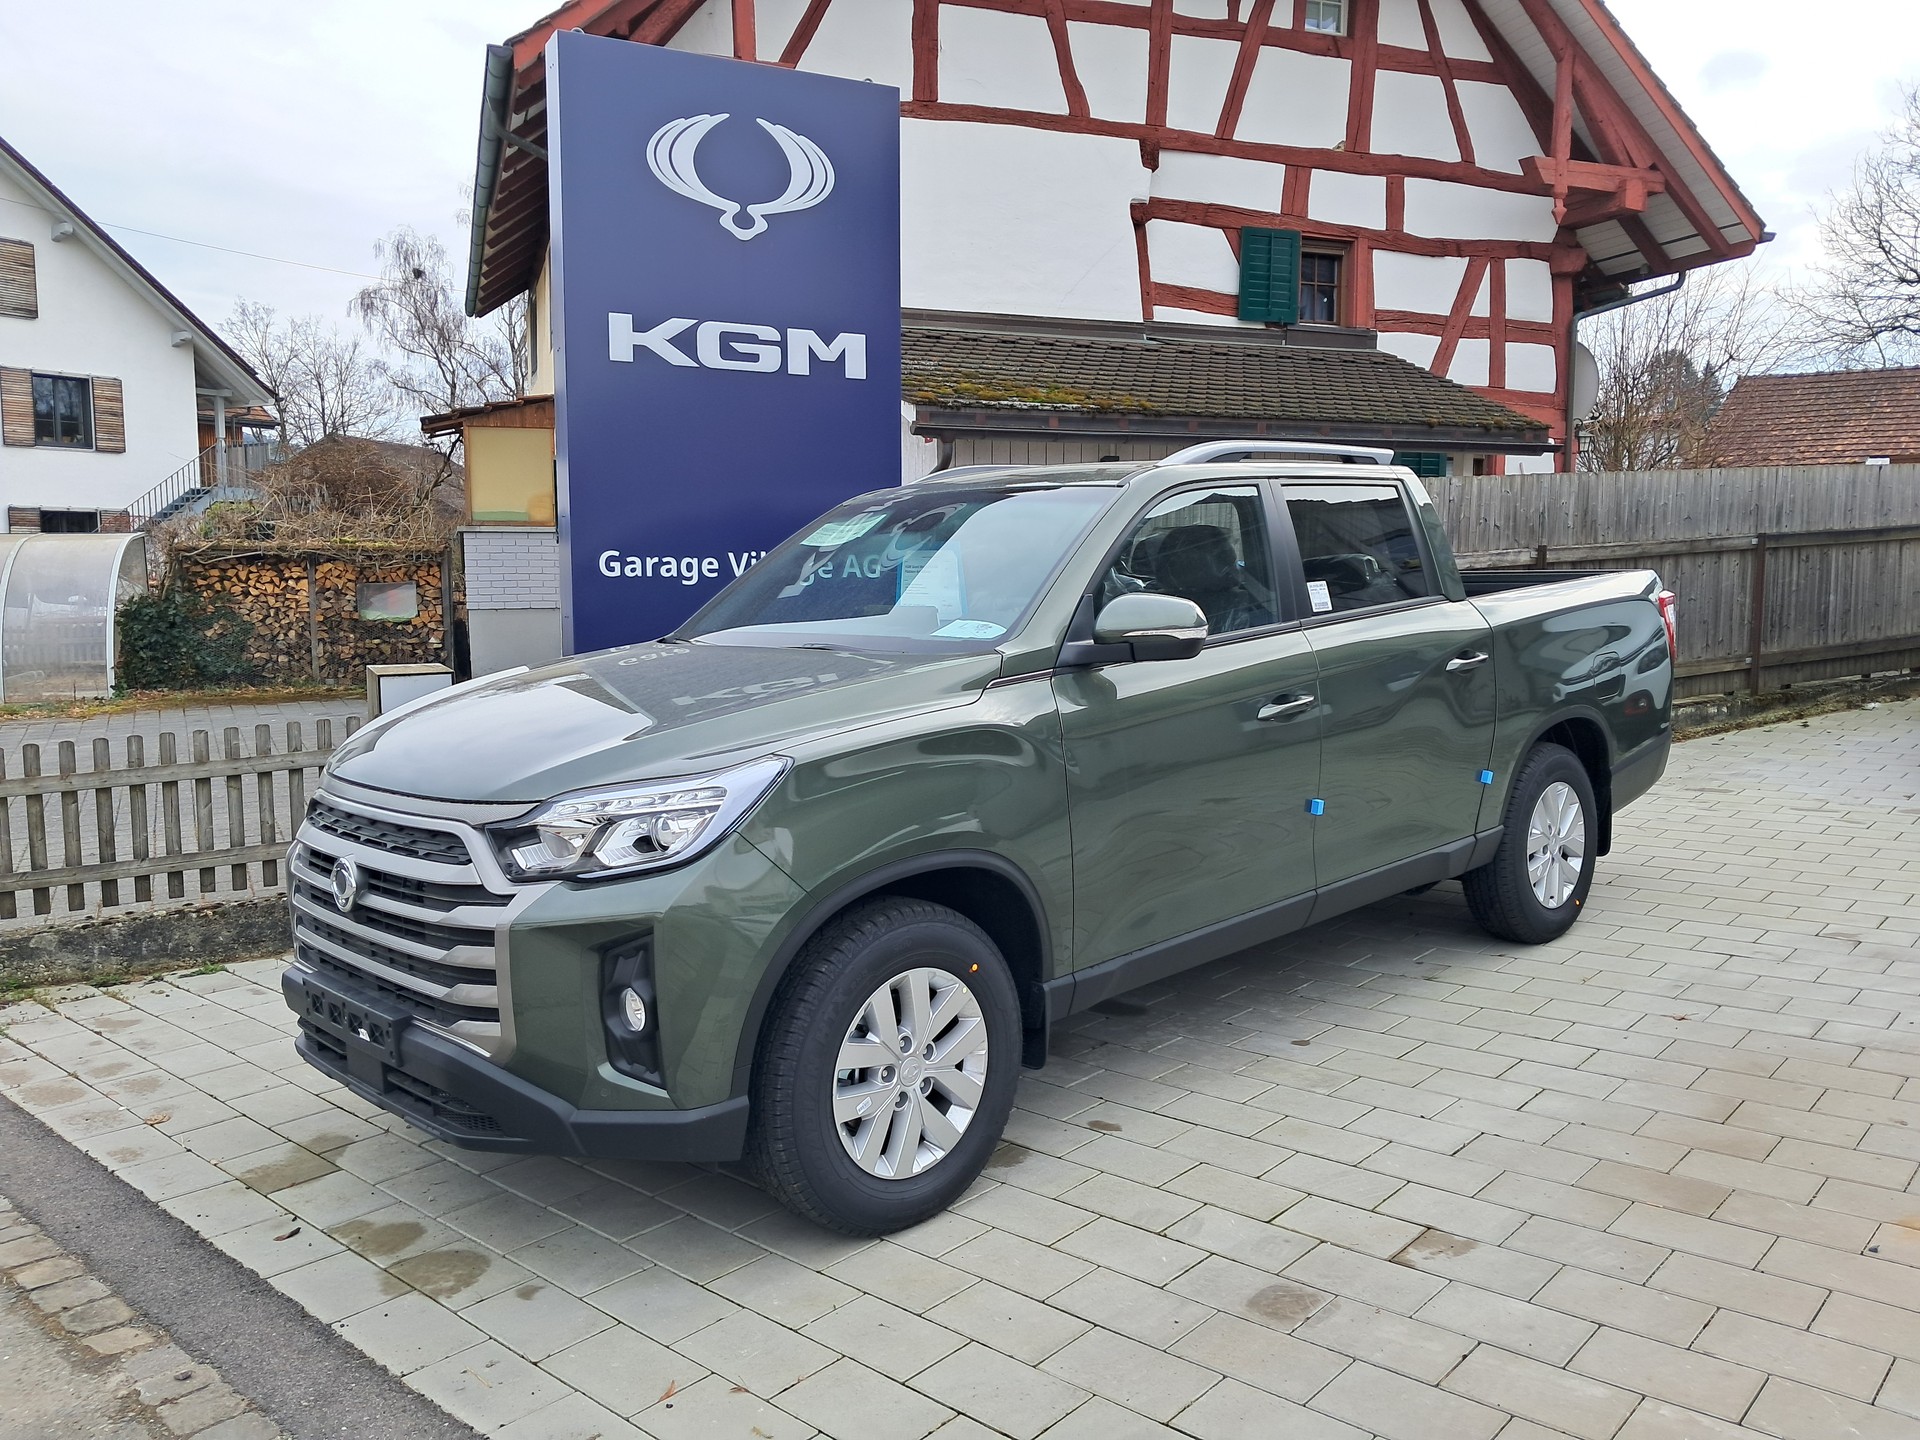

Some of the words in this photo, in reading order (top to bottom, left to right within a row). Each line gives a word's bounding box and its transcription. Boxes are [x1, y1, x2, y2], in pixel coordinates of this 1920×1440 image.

[608, 312, 867, 379] KGM
[598, 550, 719, 585] Garage
[842, 554, 880, 578] AG
